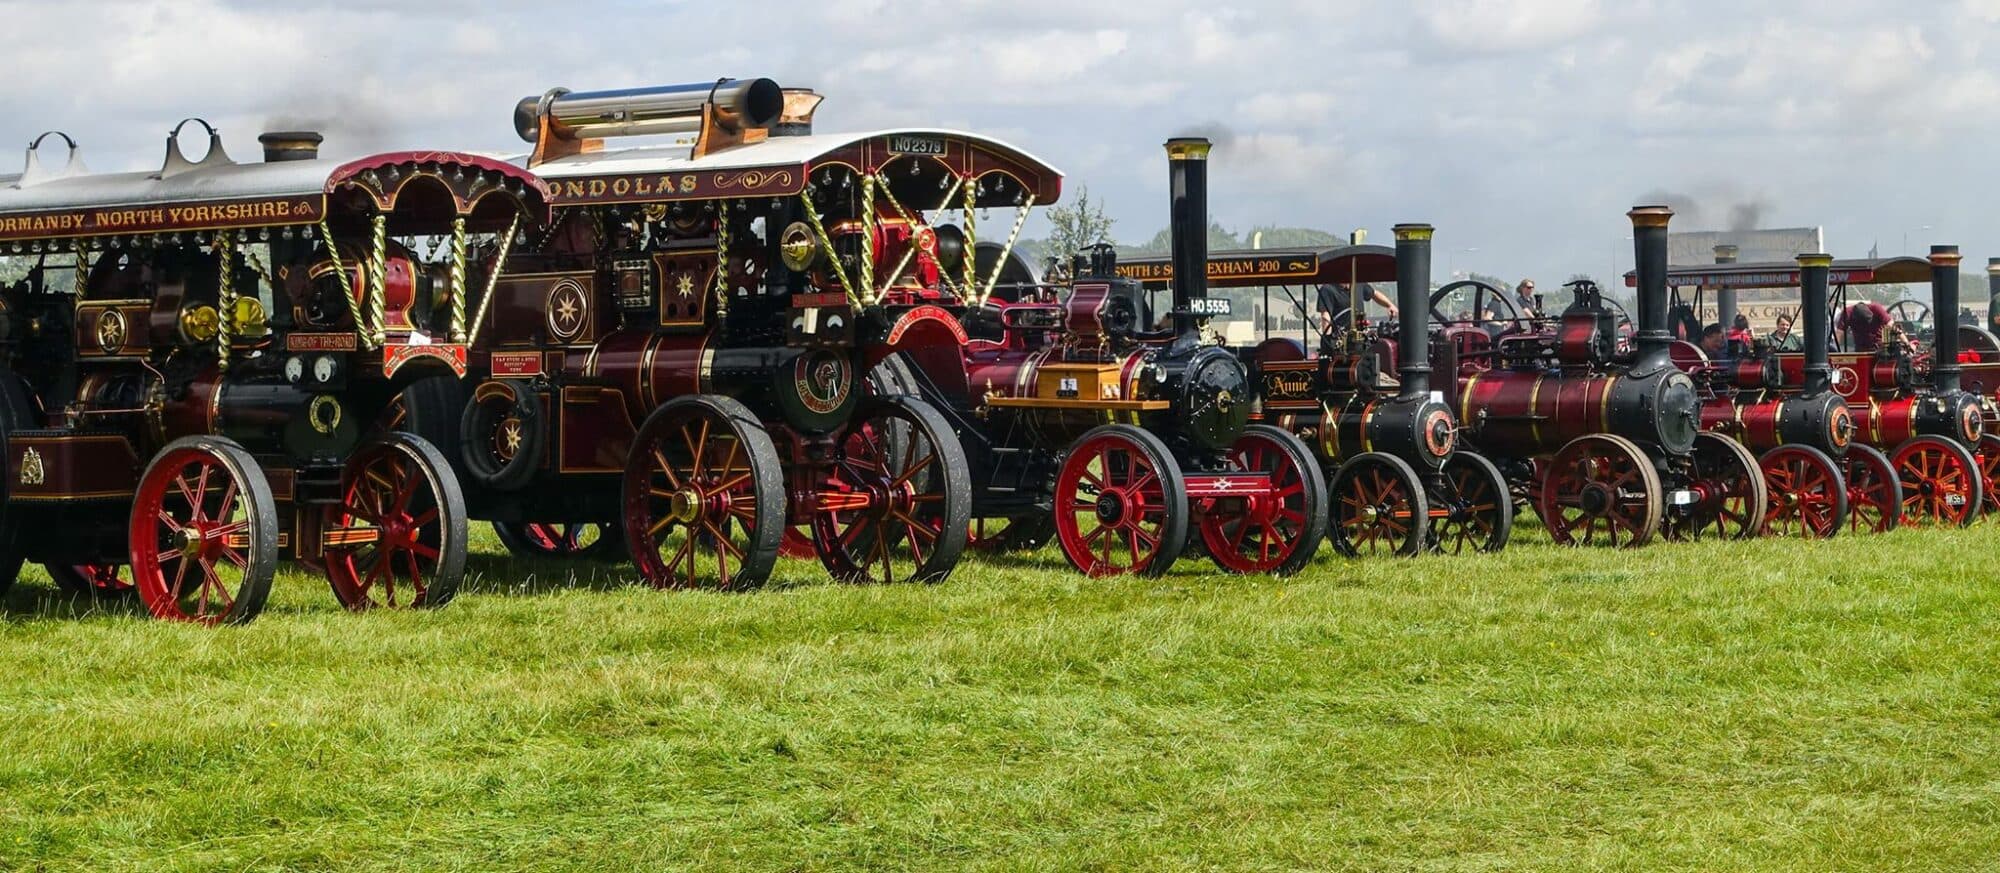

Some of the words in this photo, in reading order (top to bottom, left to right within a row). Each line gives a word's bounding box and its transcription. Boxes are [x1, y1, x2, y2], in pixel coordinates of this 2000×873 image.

[547, 174, 698, 199] ONDOLAS
[95, 209, 164, 227] NORTH
[169, 200, 289, 221] YORKSHIRE
[1114, 264, 1150, 277] SMITH
[1208, 262, 1254, 275] EXHAM
[1258, 260, 1280, 273] 200
[1668, 275, 1704, 286] OUNG
[1206, 299, 1230, 314] 5556
[1272, 375, 1309, 396] Annie
